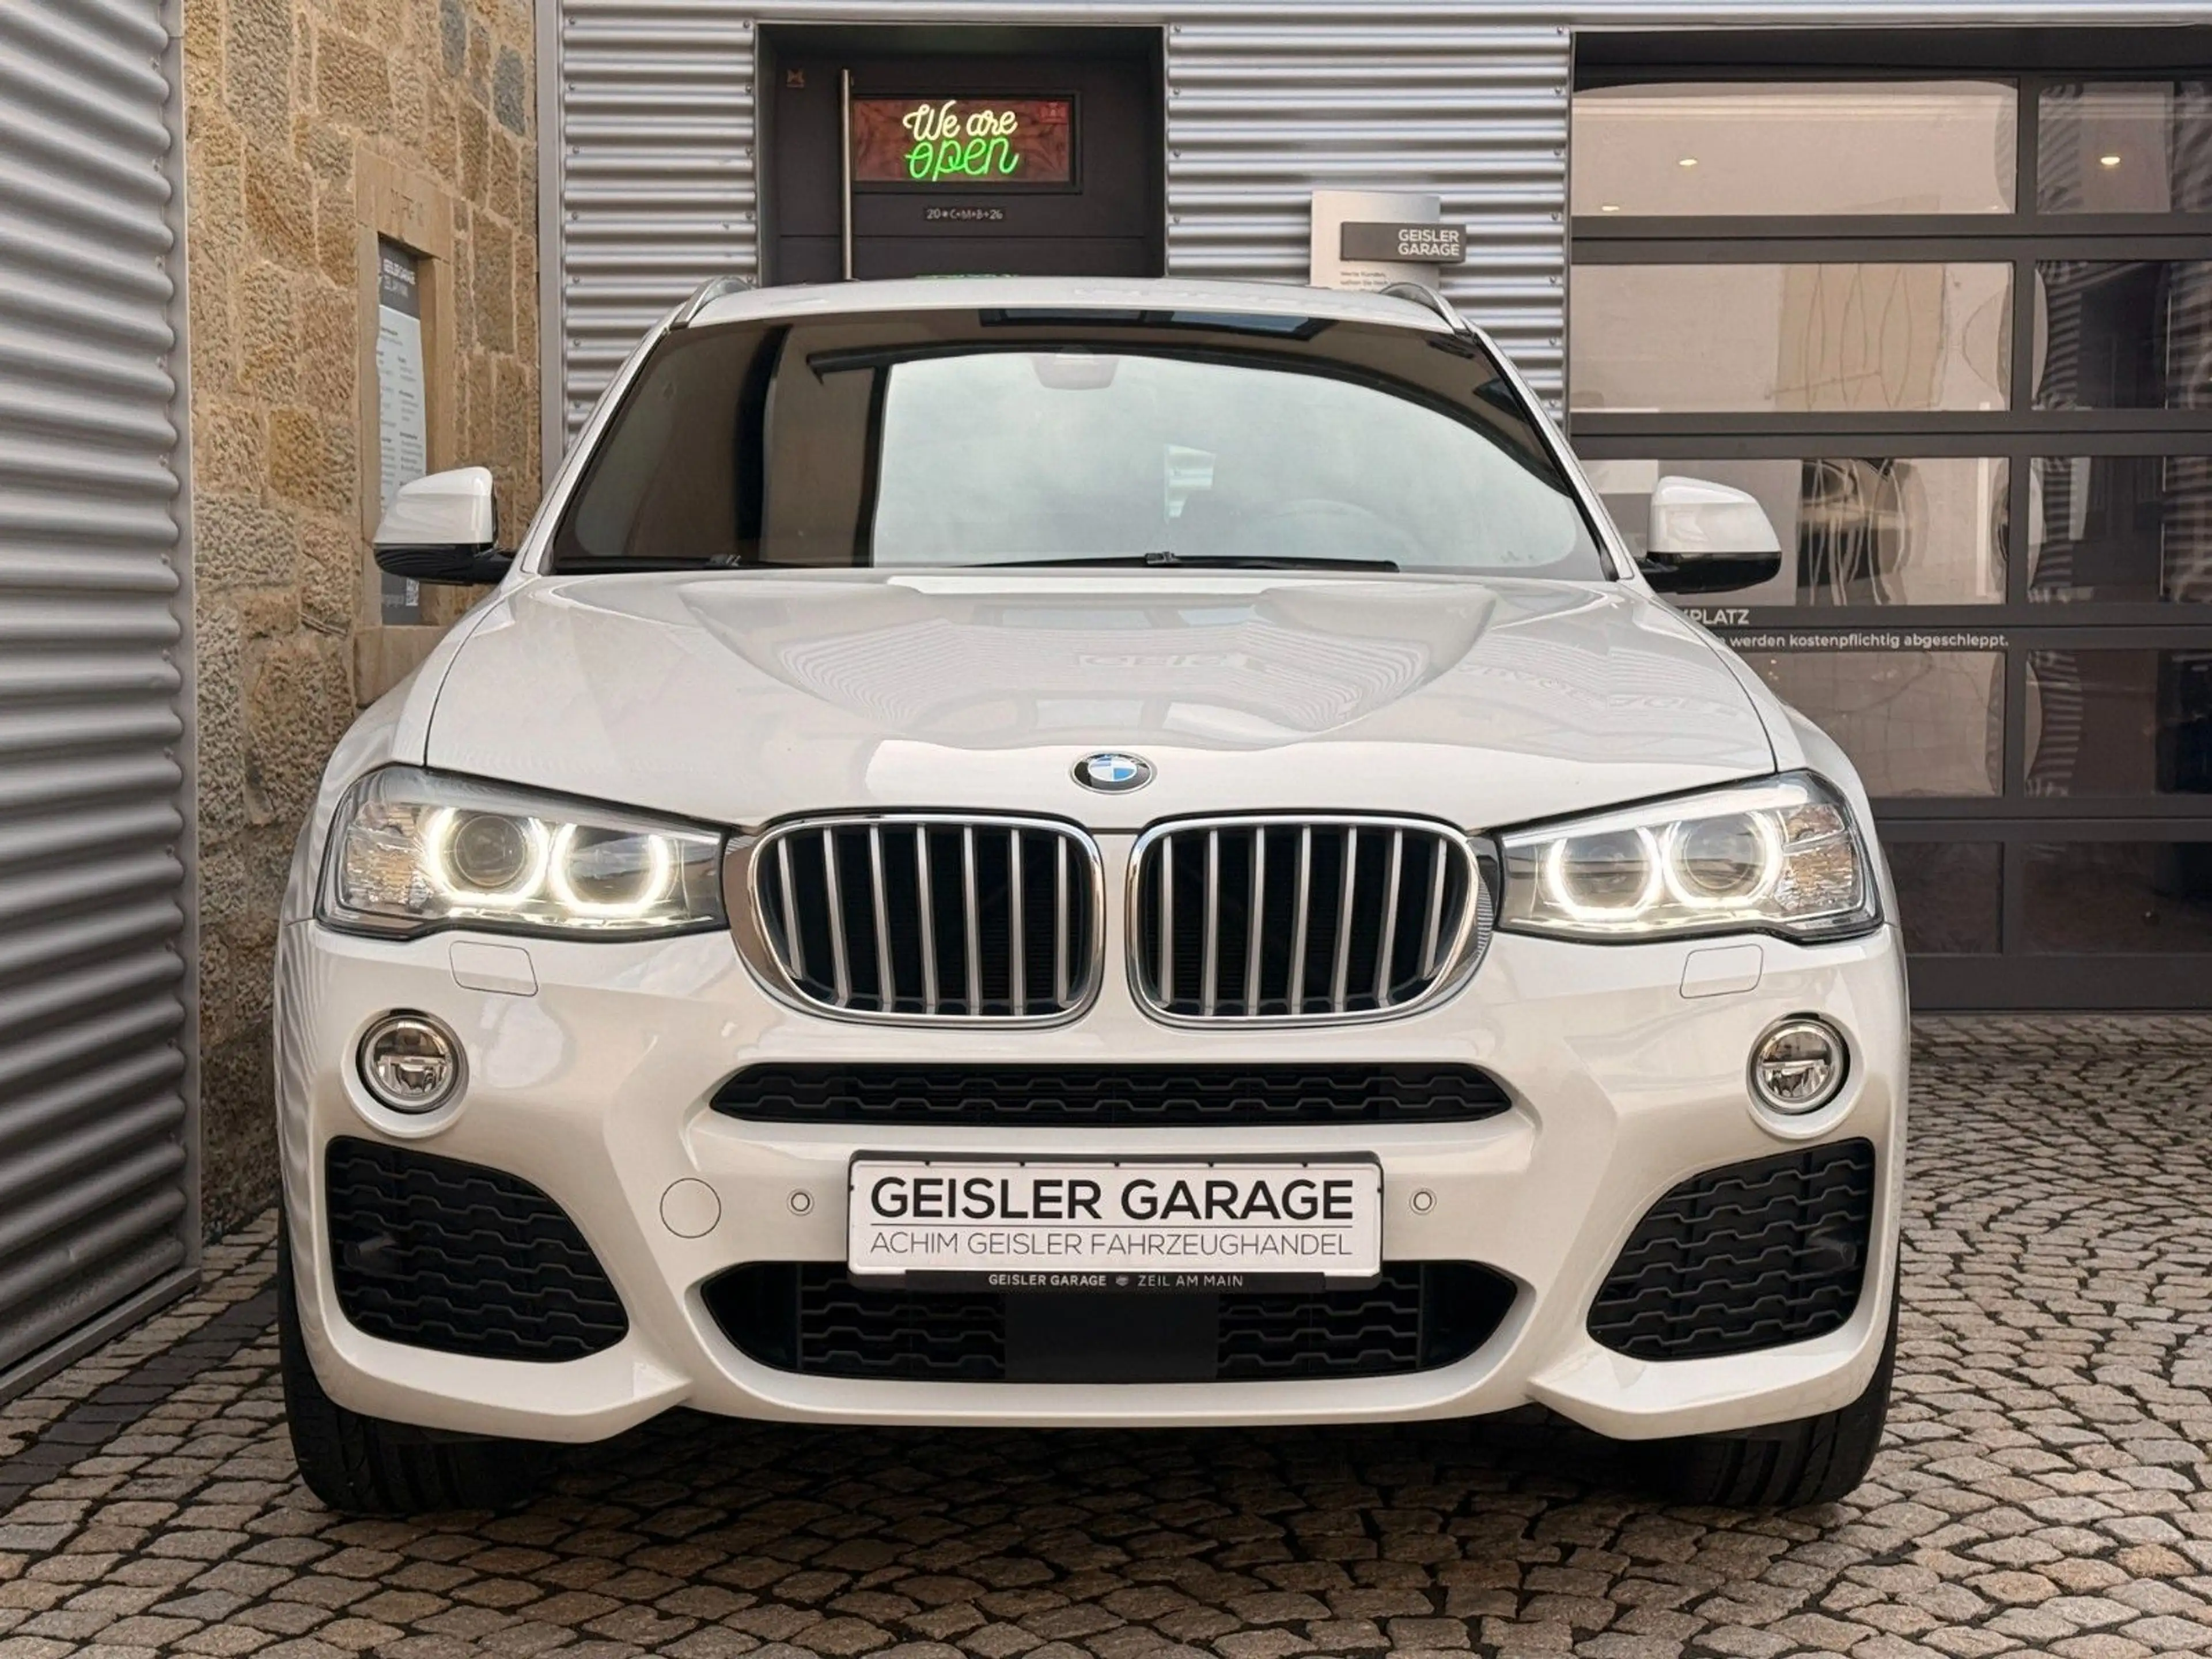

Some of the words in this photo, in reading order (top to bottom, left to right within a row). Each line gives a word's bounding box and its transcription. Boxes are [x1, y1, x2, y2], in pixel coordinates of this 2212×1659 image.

[903, 100, 961, 141] We
[966, 109, 1018, 136] are
[904, 137, 1019, 181] open
[1398, 229, 1459, 242] GEISLER
[1398, 243, 1460, 256] GARAGE
[1684, 608, 1749, 624] PLATZ
[1730, 635, 1785, 647] werden
[1790, 634, 1900, 649] kostenpflichtig
[1904, 633, 2009, 649] abgeschleppt.
[871, 1177, 1102, 1219] GEISLER
[1121, 1179, 1353, 1220] GARAGE
[870, 1232, 958, 1253] ACHIM
[968, 1233, 1082, 1255] GEISLER
[1092, 1233, 1353, 1255] FAHRZEUGHANDEL
[988, 1274, 1046, 1285] GEISLER
[1050, 1274, 1107, 1286] GARAGE
[1138, 1275, 1170, 1286] ZEIL
[1176, 1275, 1198, 1286] AM
[1204, 1275, 1243, 1286] MAIN
